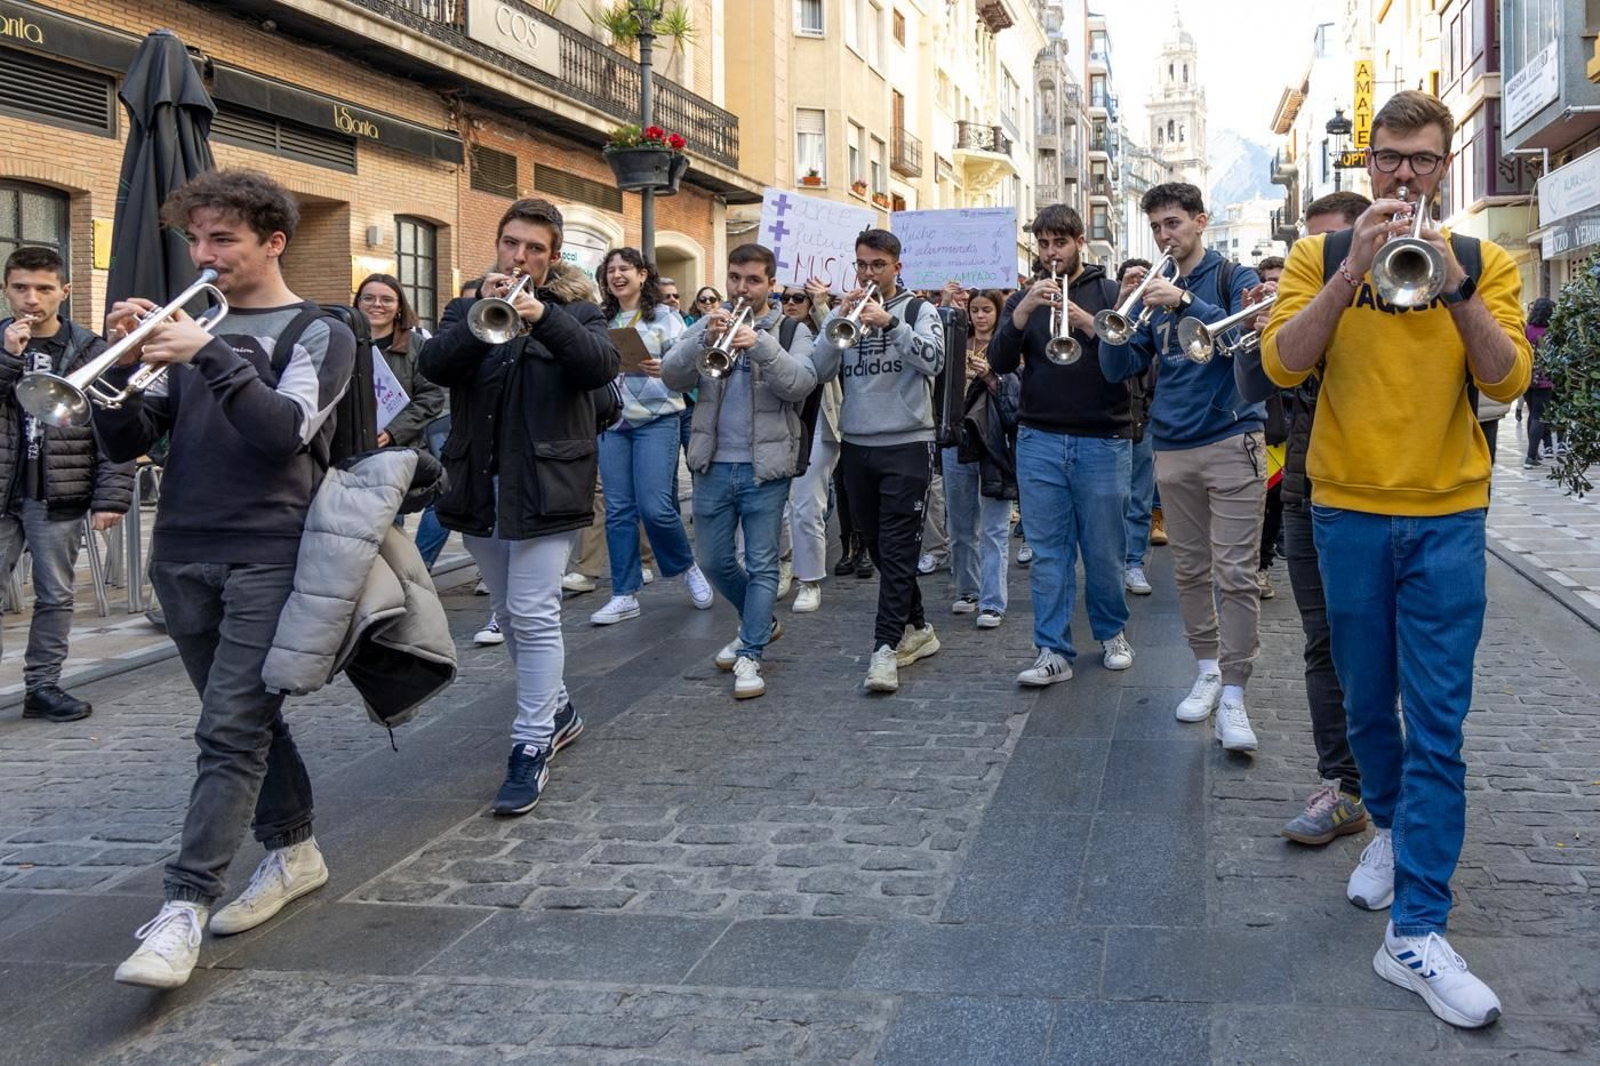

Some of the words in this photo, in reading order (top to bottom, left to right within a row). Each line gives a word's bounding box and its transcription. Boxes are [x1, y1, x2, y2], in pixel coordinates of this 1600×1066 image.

[496, 5, 539, 49] COS
[1355, 63, 1370, 145] AMATE
[794, 250, 859, 294] MÚSIC
[1156, 321, 1171, 355] 7
[844, 358, 903, 378] adidas
